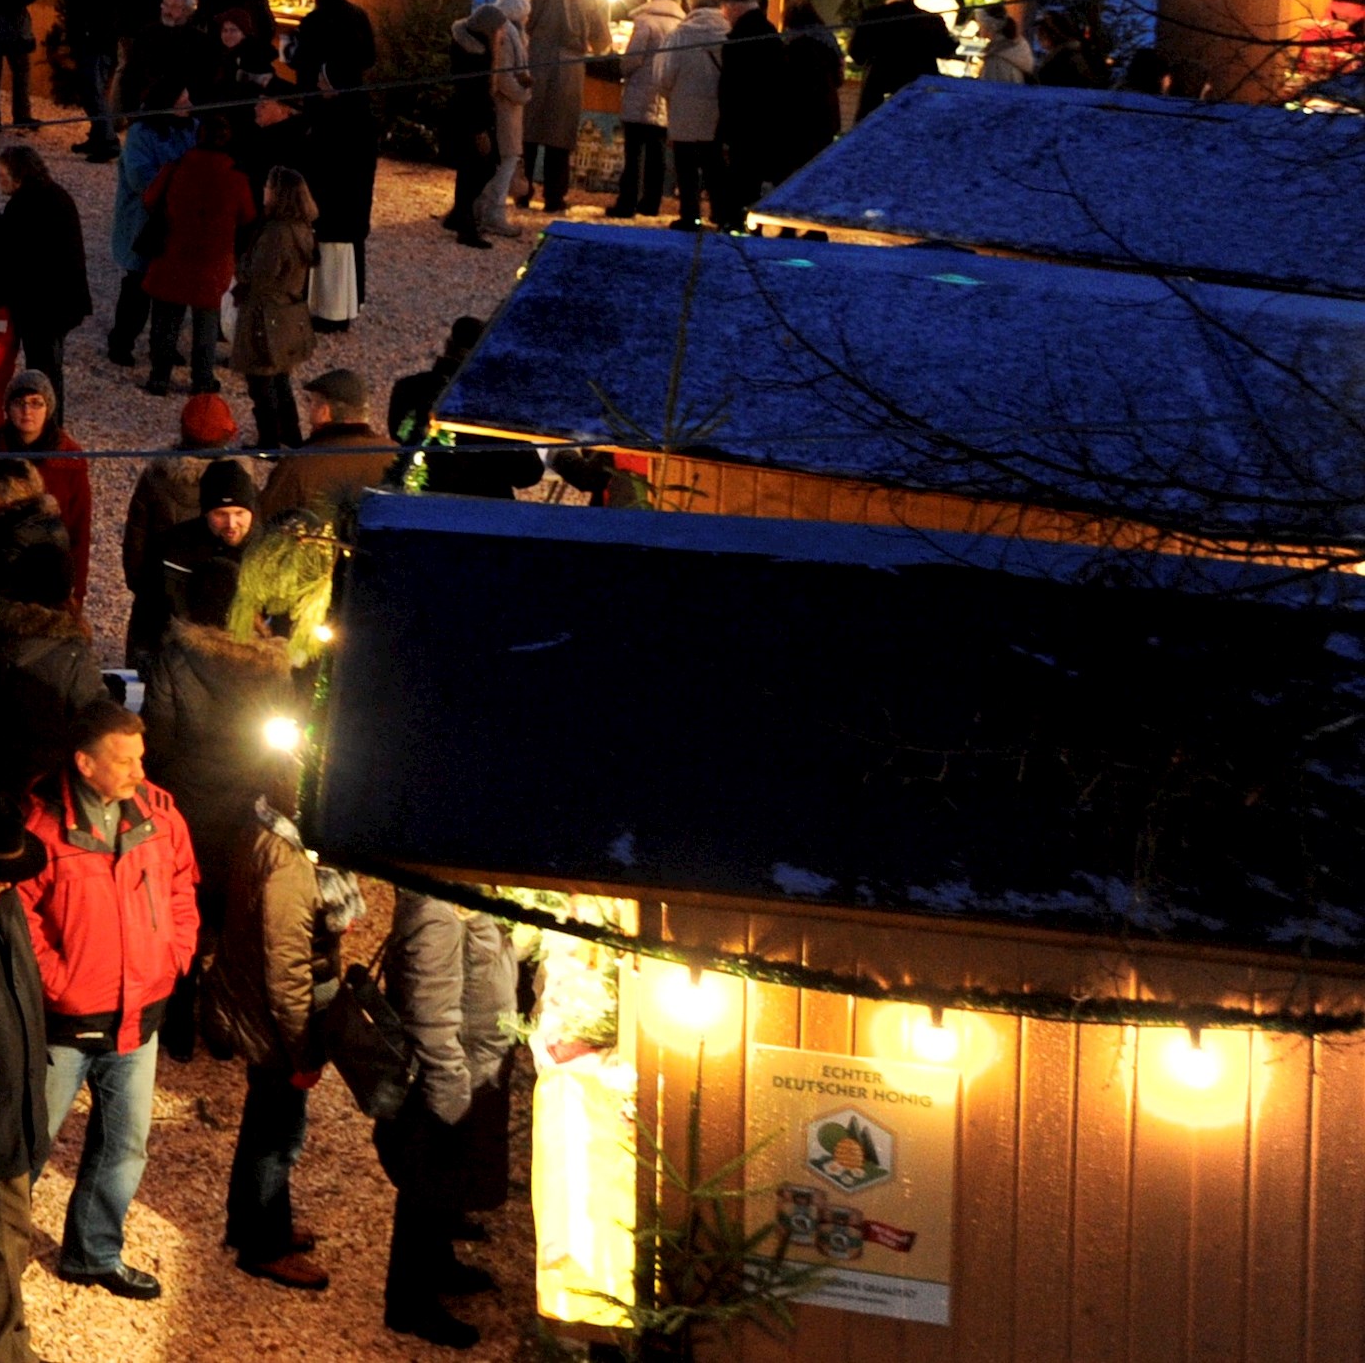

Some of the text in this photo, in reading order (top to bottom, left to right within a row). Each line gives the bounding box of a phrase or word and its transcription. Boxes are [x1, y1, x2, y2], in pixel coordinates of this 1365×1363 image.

[822, 1064, 884, 1084] ECHTER
[773, 1075, 933, 1108] DEUTSCHER HONIG
